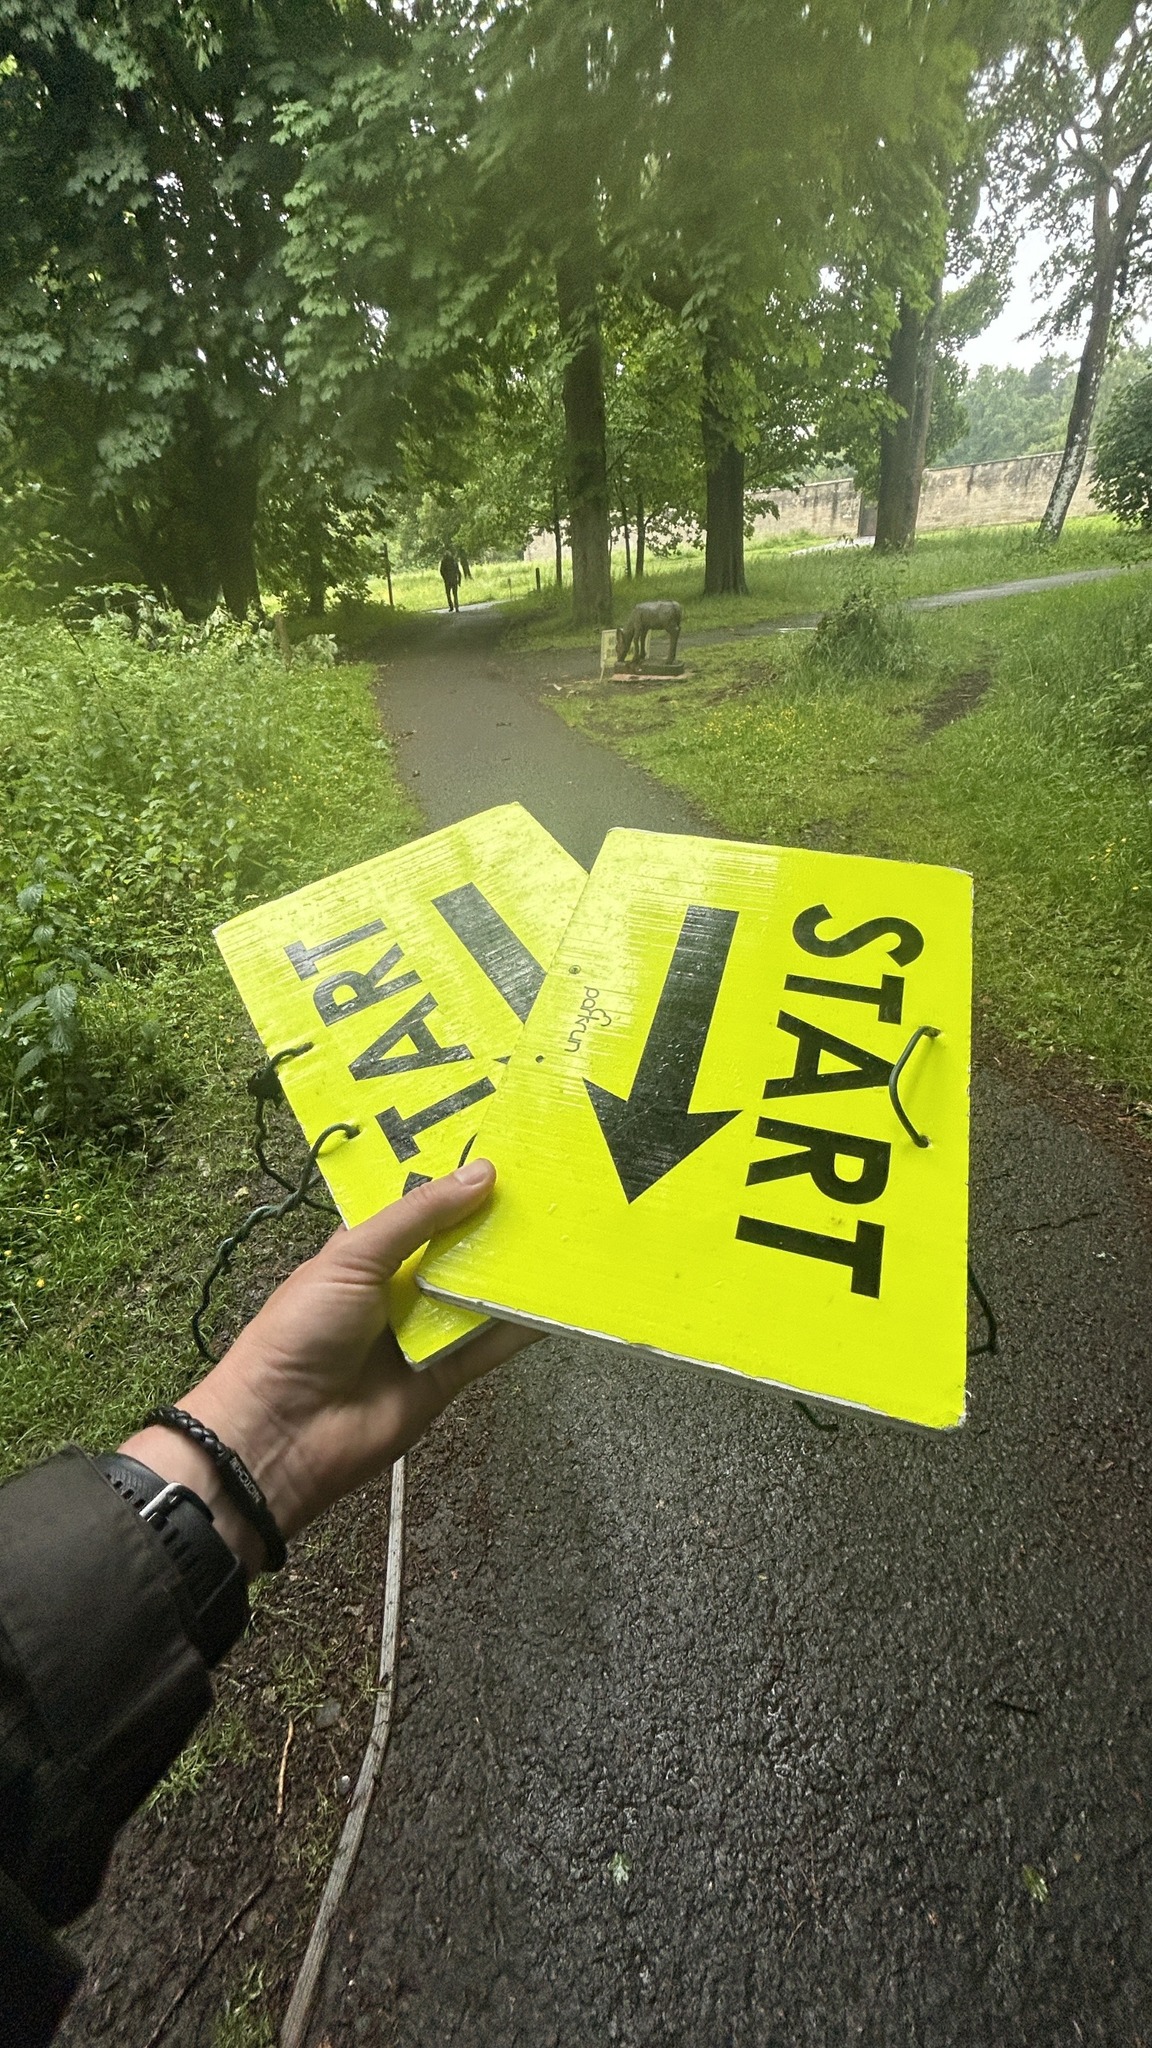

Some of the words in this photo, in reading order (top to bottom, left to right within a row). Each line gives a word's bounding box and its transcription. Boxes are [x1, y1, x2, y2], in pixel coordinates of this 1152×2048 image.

[283, 918, 497, 1198] TART
[563, 985, 607, 1053] parkrun
[734, 903, 925, 1300] START
